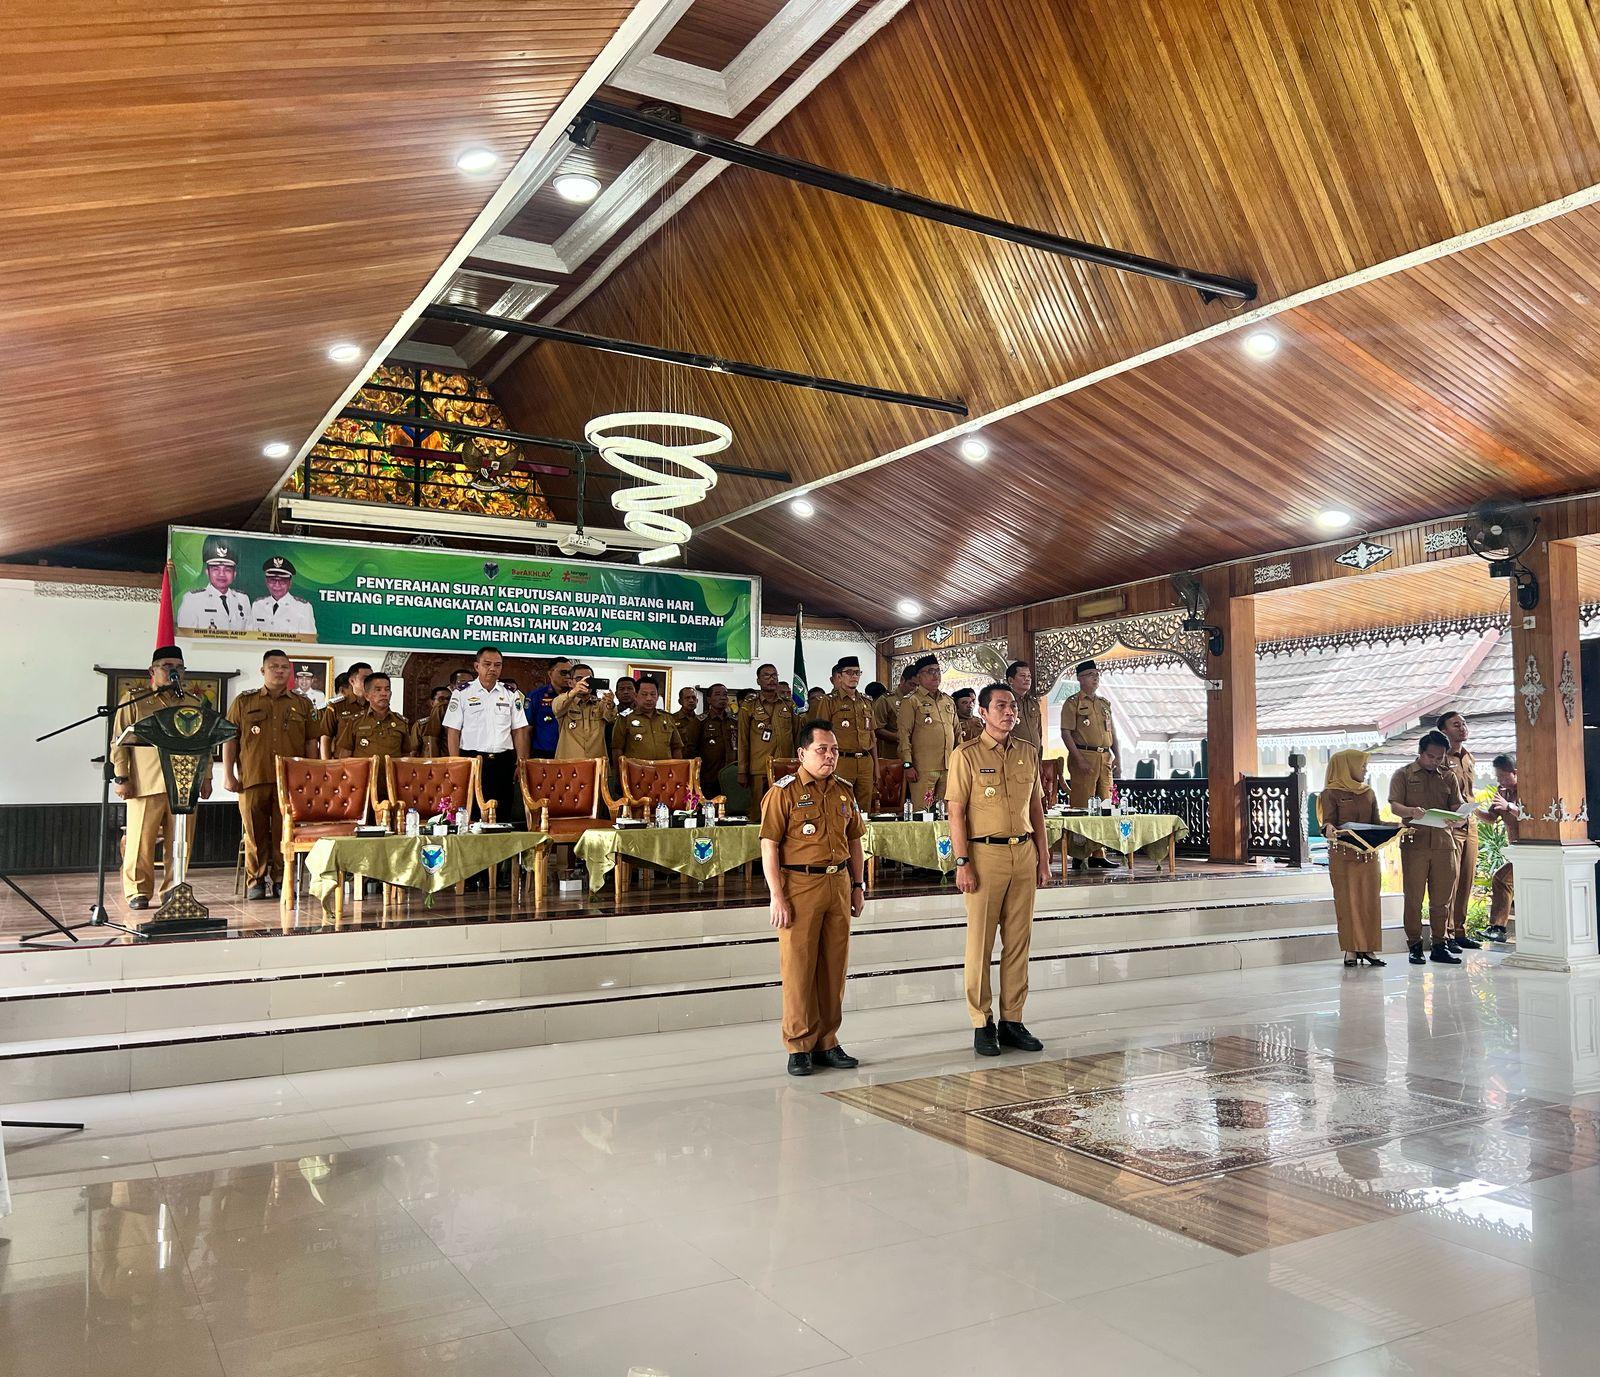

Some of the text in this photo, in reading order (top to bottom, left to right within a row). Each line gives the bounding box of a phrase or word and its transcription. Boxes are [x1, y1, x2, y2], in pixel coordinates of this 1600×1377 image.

[319, 589, 724, 627] TENTANG PENGANGKATAN CALON PEGAWAI NEGERI SIPIL DAERAH
[356, 576, 694, 611] PENYERAHAN SURAT KEPUTUSAN BUPATI BATANG HARI
[351, 623, 697, 652] DI LINGKUNGAN PEMERINTAH KABUPATEN BATANG HARI
[466, 614, 602, 633] FORMASI TAHUN 2024
